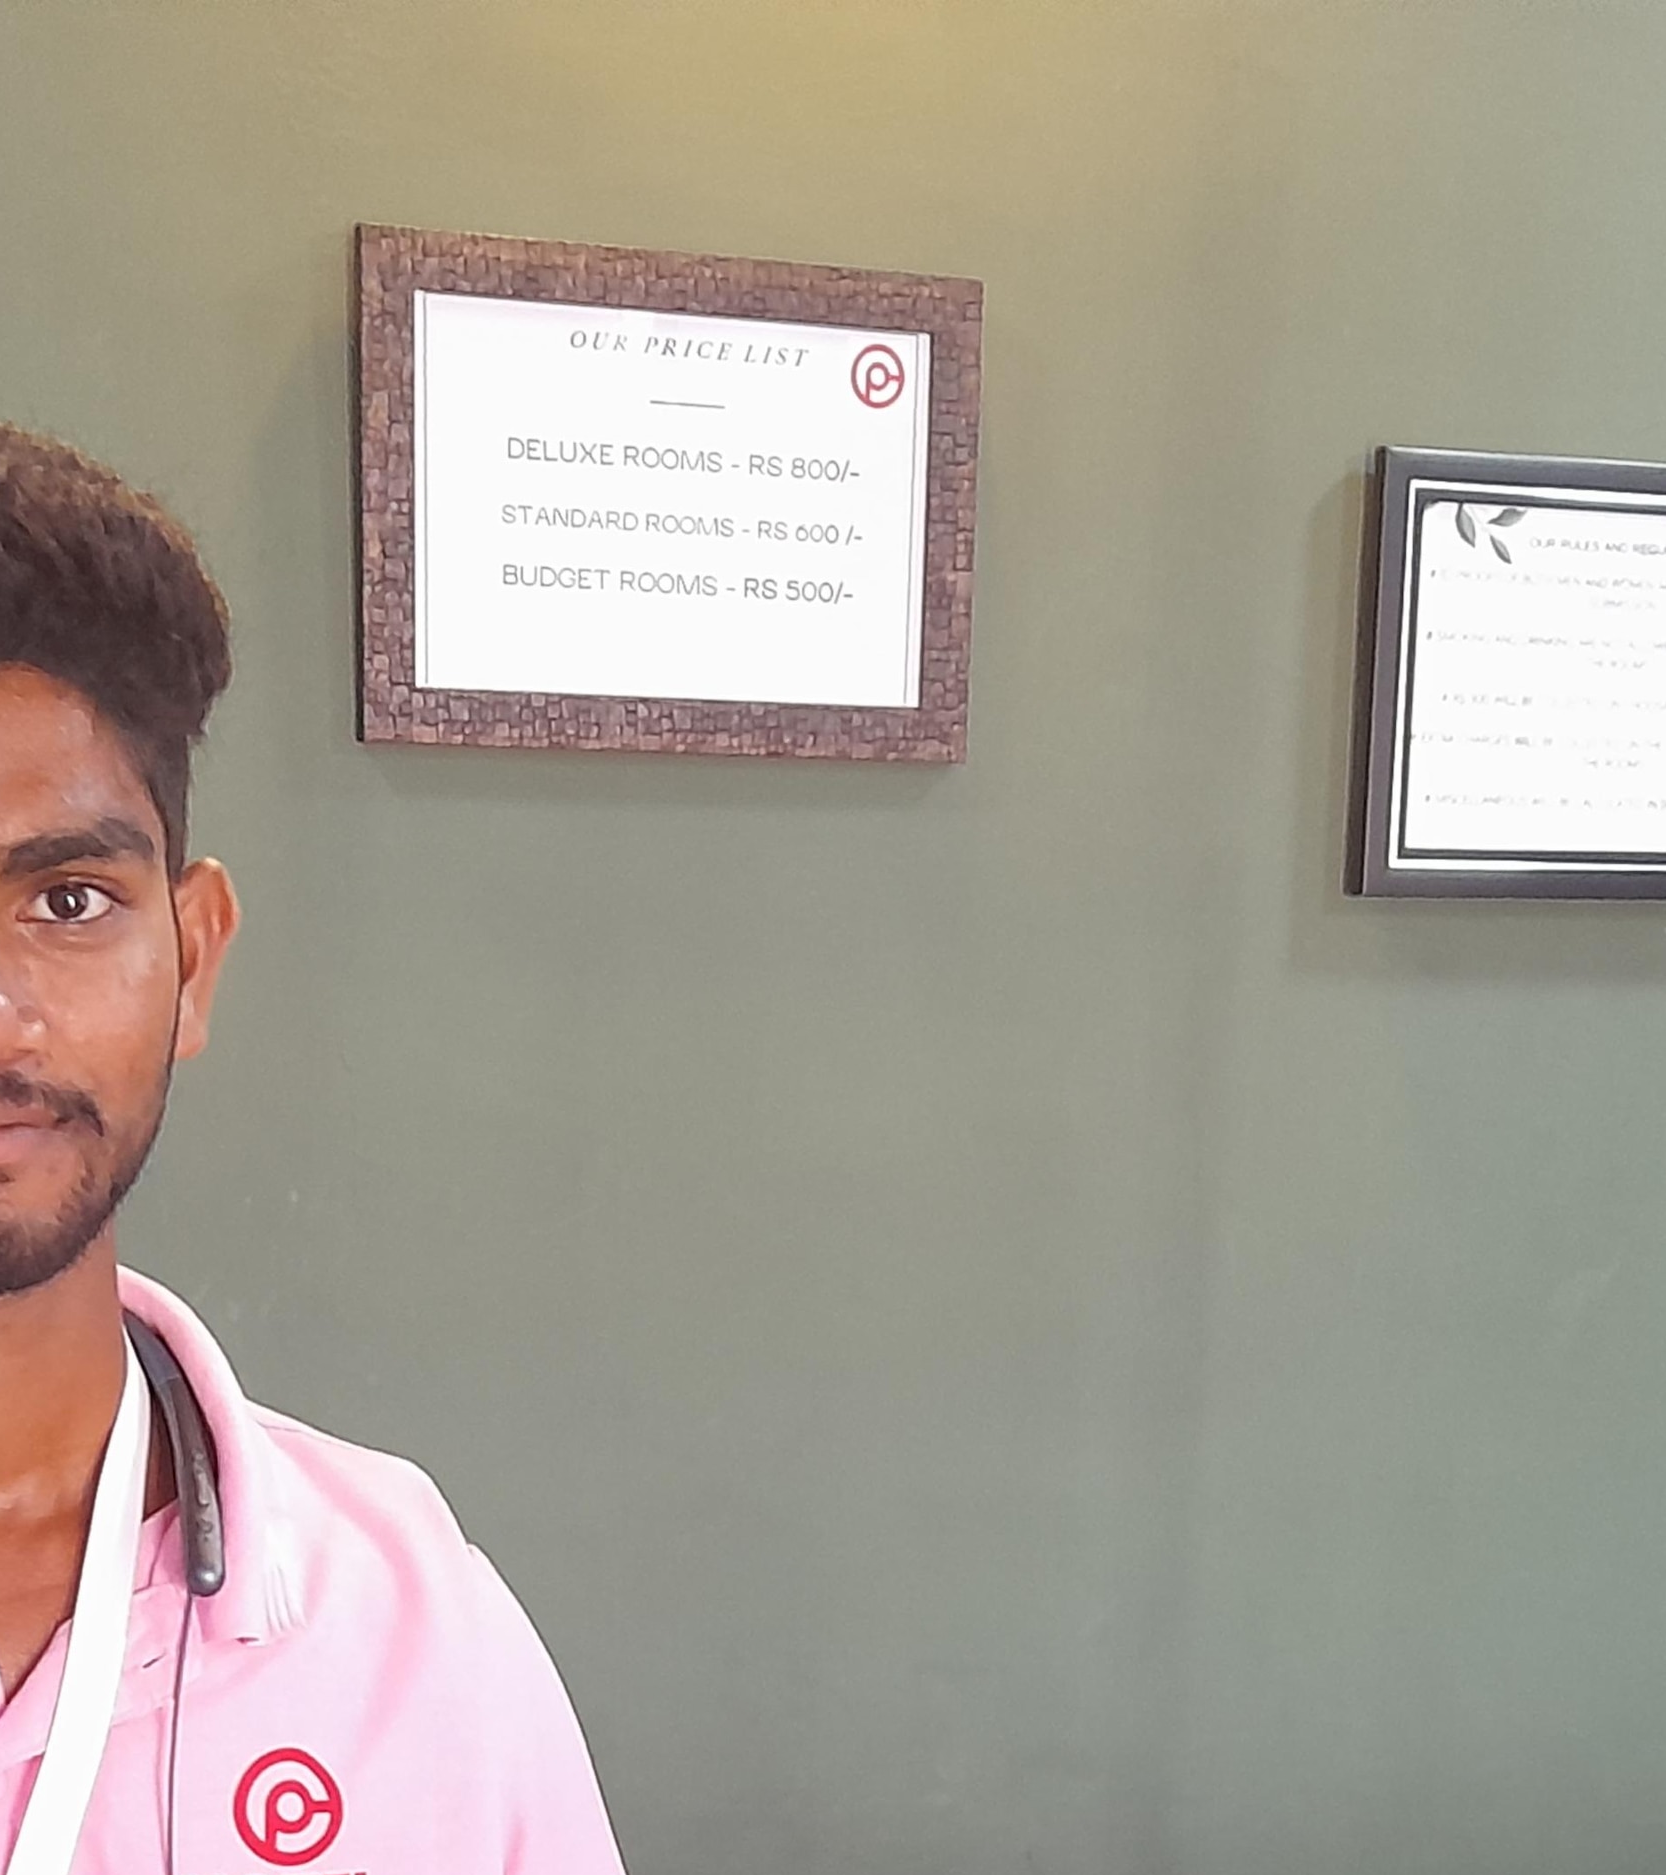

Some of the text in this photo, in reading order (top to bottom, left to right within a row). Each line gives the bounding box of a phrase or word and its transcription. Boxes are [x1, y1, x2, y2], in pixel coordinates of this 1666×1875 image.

[569, 329, 810, 367] OUR PRICE LIST
[507, 436, 614, 466] DELUXE
[623, 445, 723, 473] ROOMS
[748, 453, 783, 477] RS
[790, 457, 860, 482] 800/-
[501, 504, 639, 532] STANDARD
[645, 513, 735, 538] ROOMS
[757, 520, 788, 541] RS
[795, 524, 840, 544] 600
[502, 563, 611, 590] BUDGET
[620, 570, 718, 597] ROOMS
[744, 577, 778, 600] RS
[785, 580, 853, 605] 500/-
